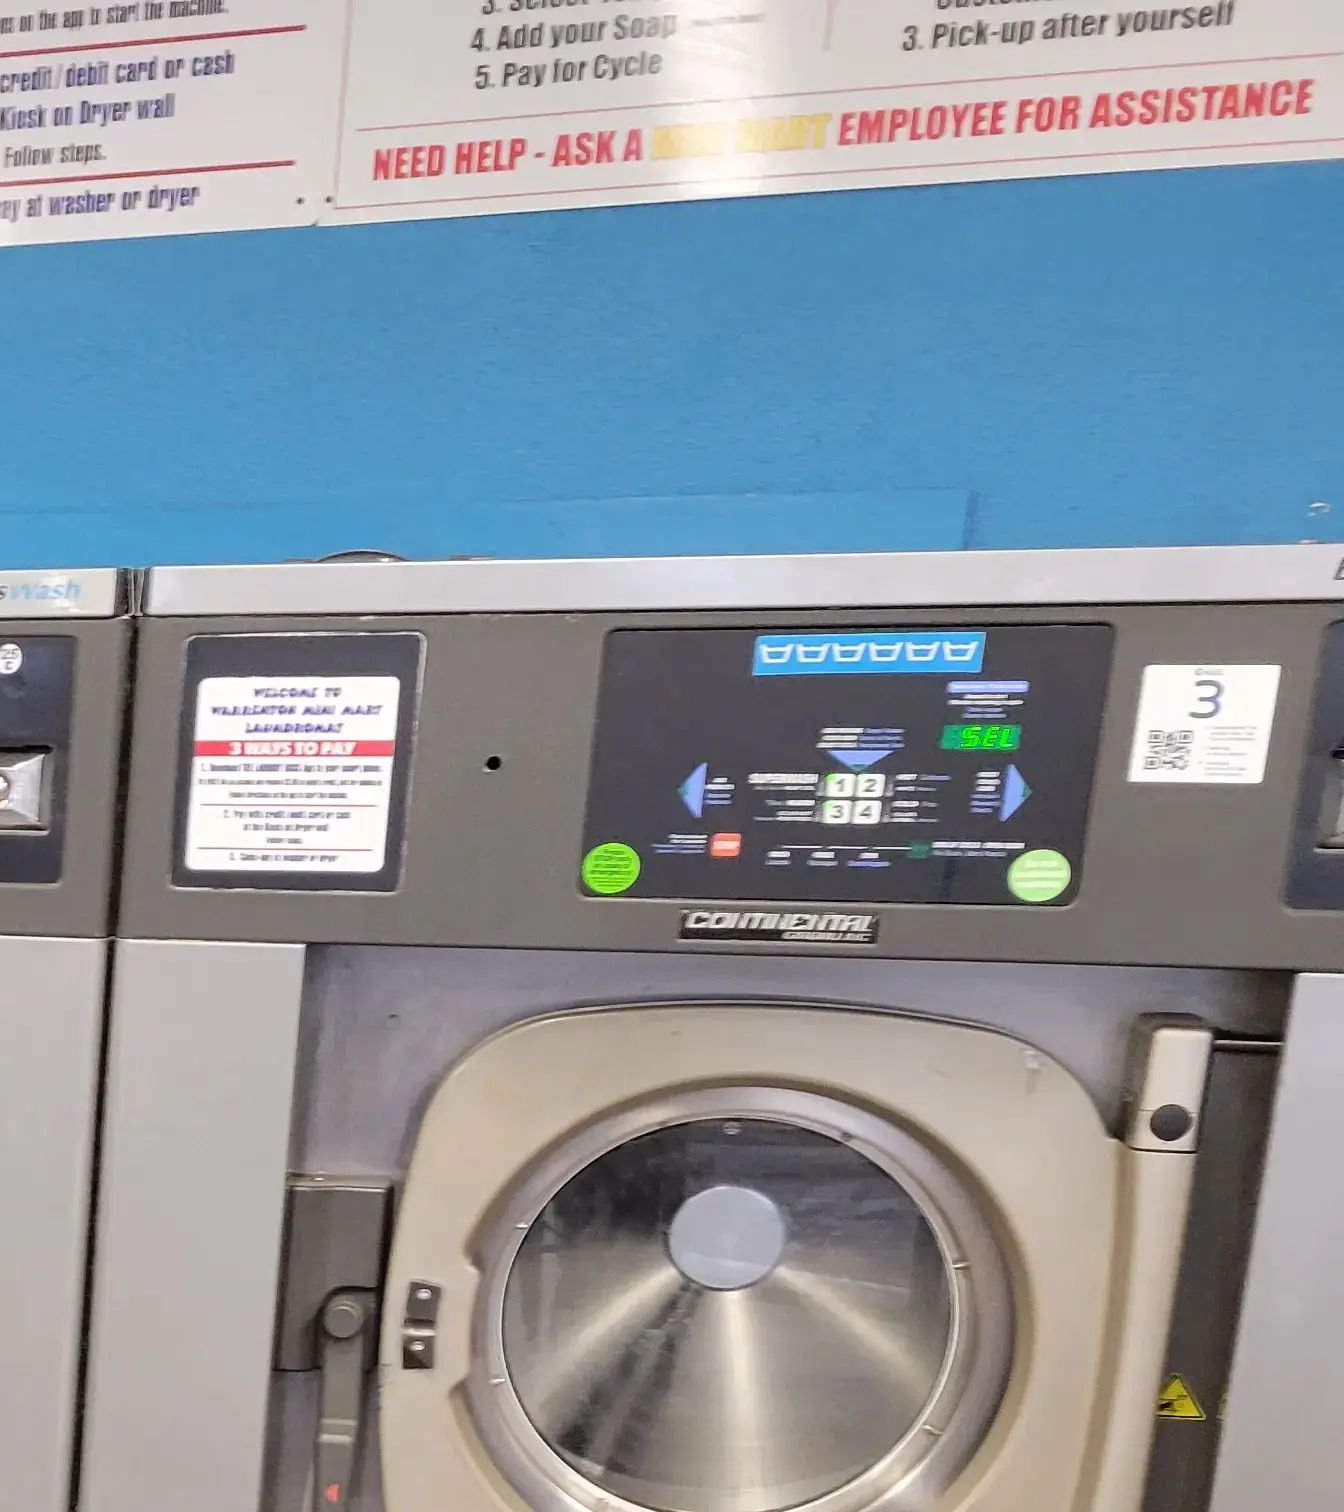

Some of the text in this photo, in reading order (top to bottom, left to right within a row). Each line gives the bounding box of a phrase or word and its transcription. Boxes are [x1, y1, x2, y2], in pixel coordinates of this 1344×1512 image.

[39, 9, 57, 31] the
[62, 12, 84, 32] app
[89, 7, 100, 26] to
[106, 3, 140, 24] start
[144, 1, 163, 21] the
[471, 27, 491, 52] 4.
[495, 22, 545, 51] Add
[549, 20, 608, 49] your
[612, 14, 679, 40] Soap
[901, 0, 1235, 51] 3. Pick-up after yourself
[115, 55, 158, 84] card
[164, 58, 185, 80] or
[191, 50, 236, 78] cash
[474, 50, 663, 90] 5. Pay for Cycle
[0, 104, 47, 132] Kiosk
[52, 105, 74, 127] on
[79, 99, 132, 128] Dryer
[137, 92, 176, 120] wall
[372, 144, 447, 181] NEED
[453, 137, 529, 175] HELP
[551, 130, 617, 167] ASK
[622, 127, 644, 162] A
[836, 100, 1008, 146] EMPLOYEE
[1014, 94, 1081, 135] FOR
[1089, 78, 1316, 129] ASSISTANCE
[3, 142, 107, 168] Follow steps.
[26, 193, 43, 218] at
[48, 188, 116, 217] washer
[121, 189, 141, 211] or
[148, 184, 201, 212] dryer
[1188, 679, 1225, 719] 3
[228, 741, 357, 756] 3 WAYS TO PAY
[961, 726, 1014, 748] SEL
[836, 778, 878, 794] 1 2
[830, 804, 874, 819] 3 4
